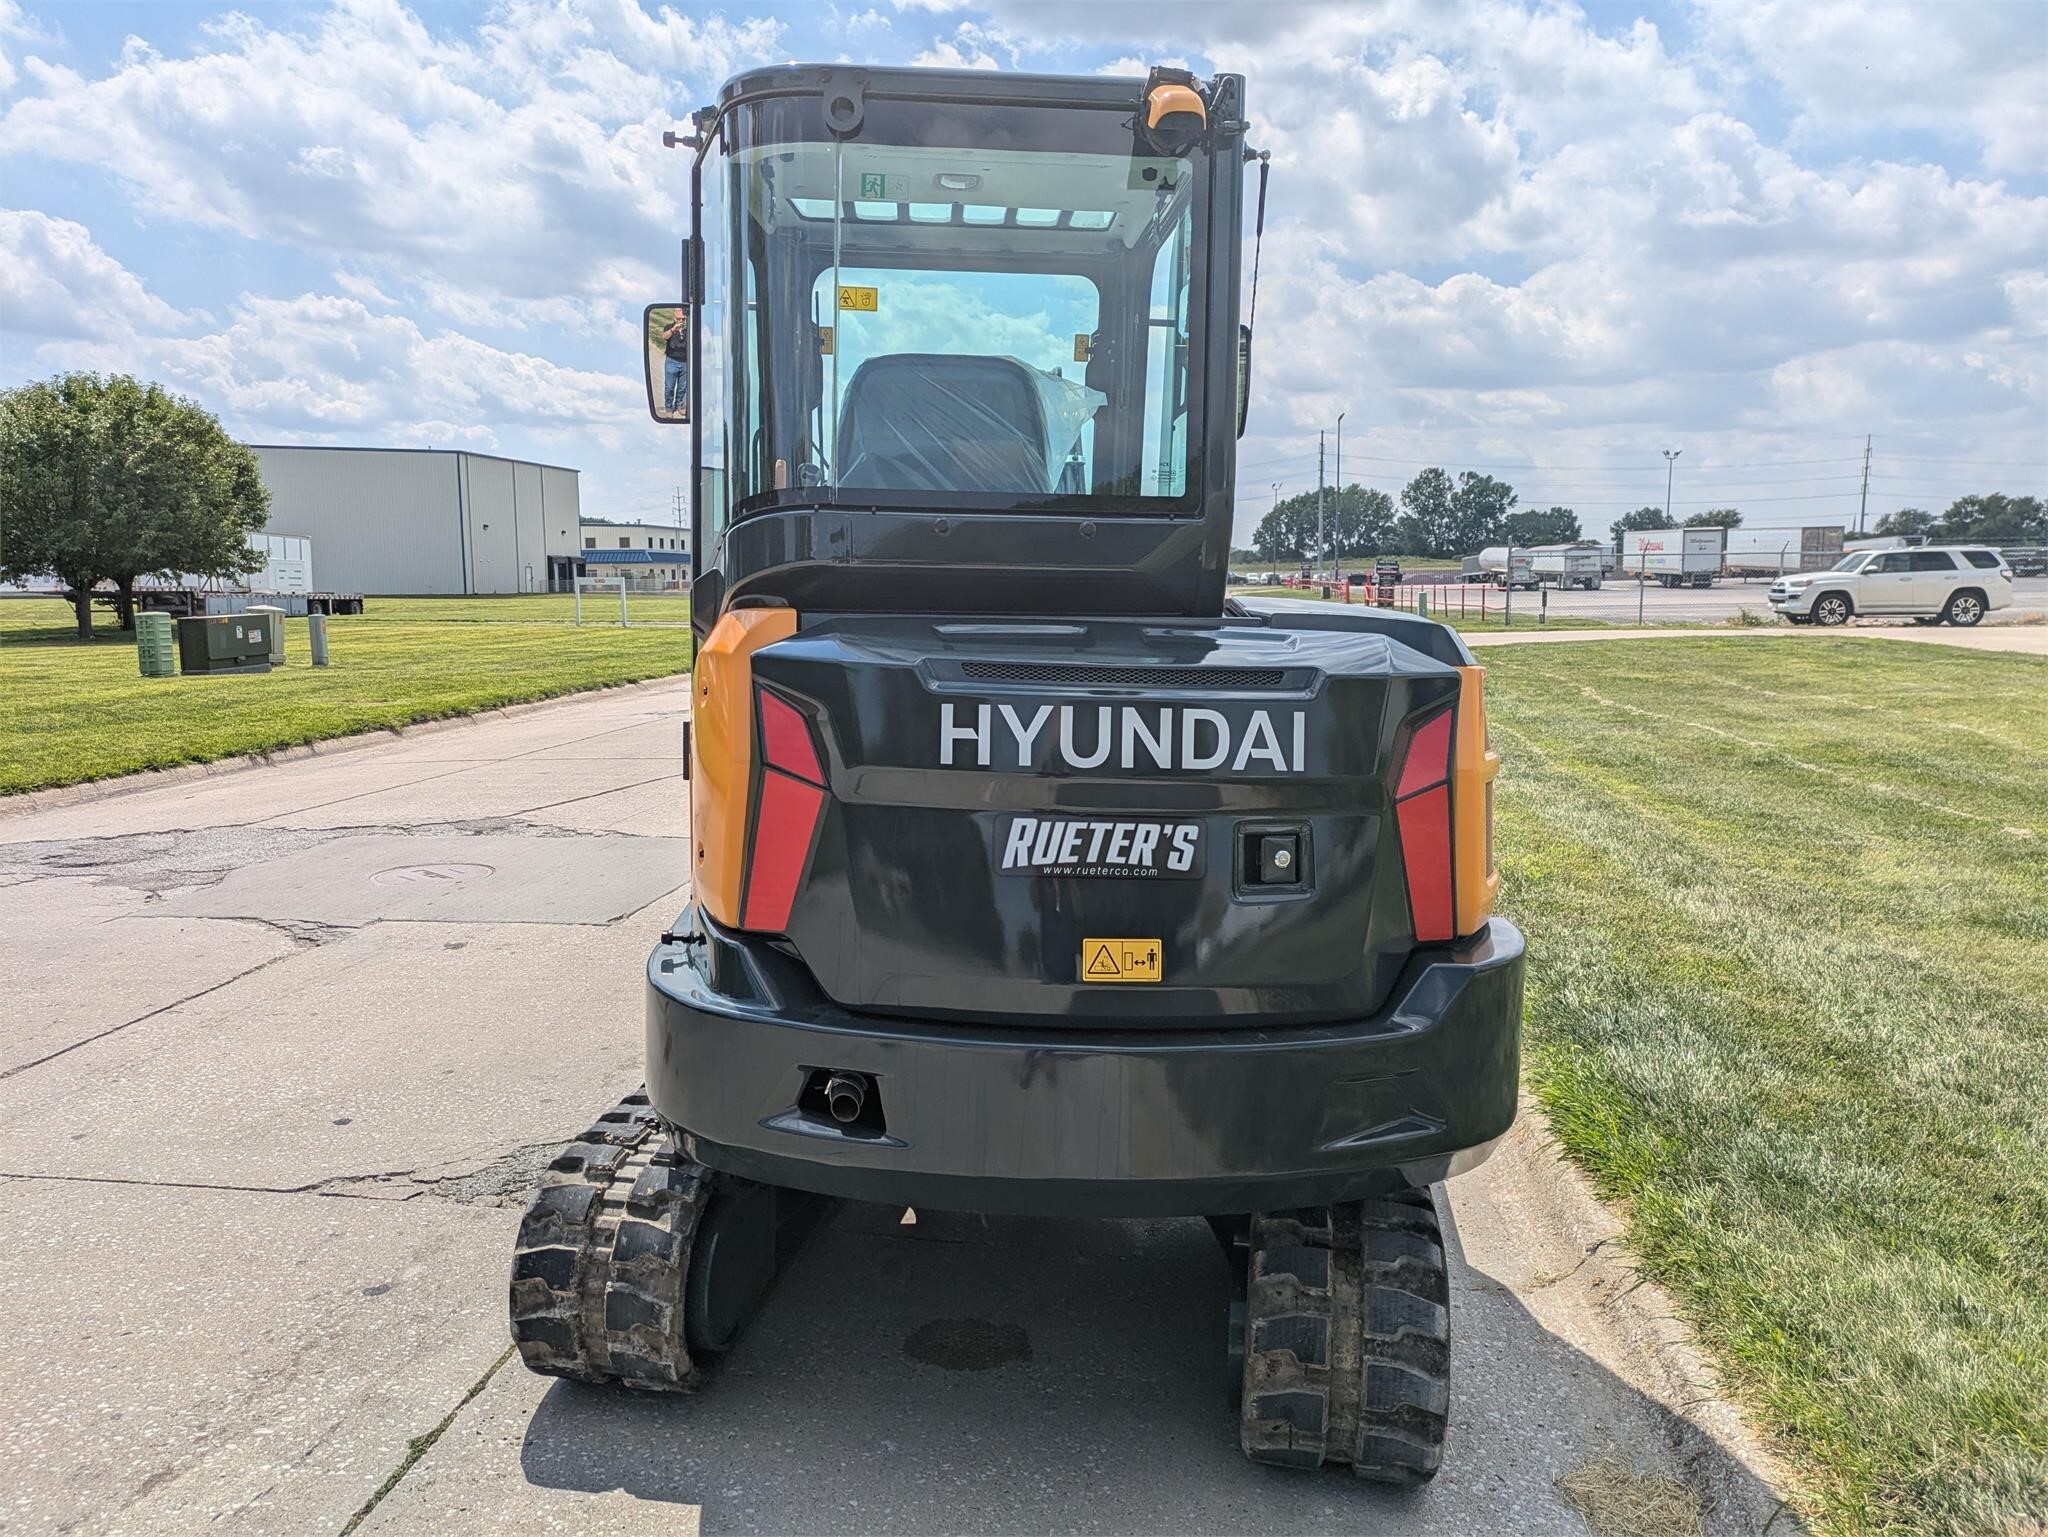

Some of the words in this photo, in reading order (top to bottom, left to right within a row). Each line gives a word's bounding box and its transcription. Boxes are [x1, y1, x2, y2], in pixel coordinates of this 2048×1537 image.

[941, 704, 1304, 772] HYUNDAI
[1002, 818, 1199, 872] RUETER'S
[1043, 867, 1158, 876] www.rueterco.com
